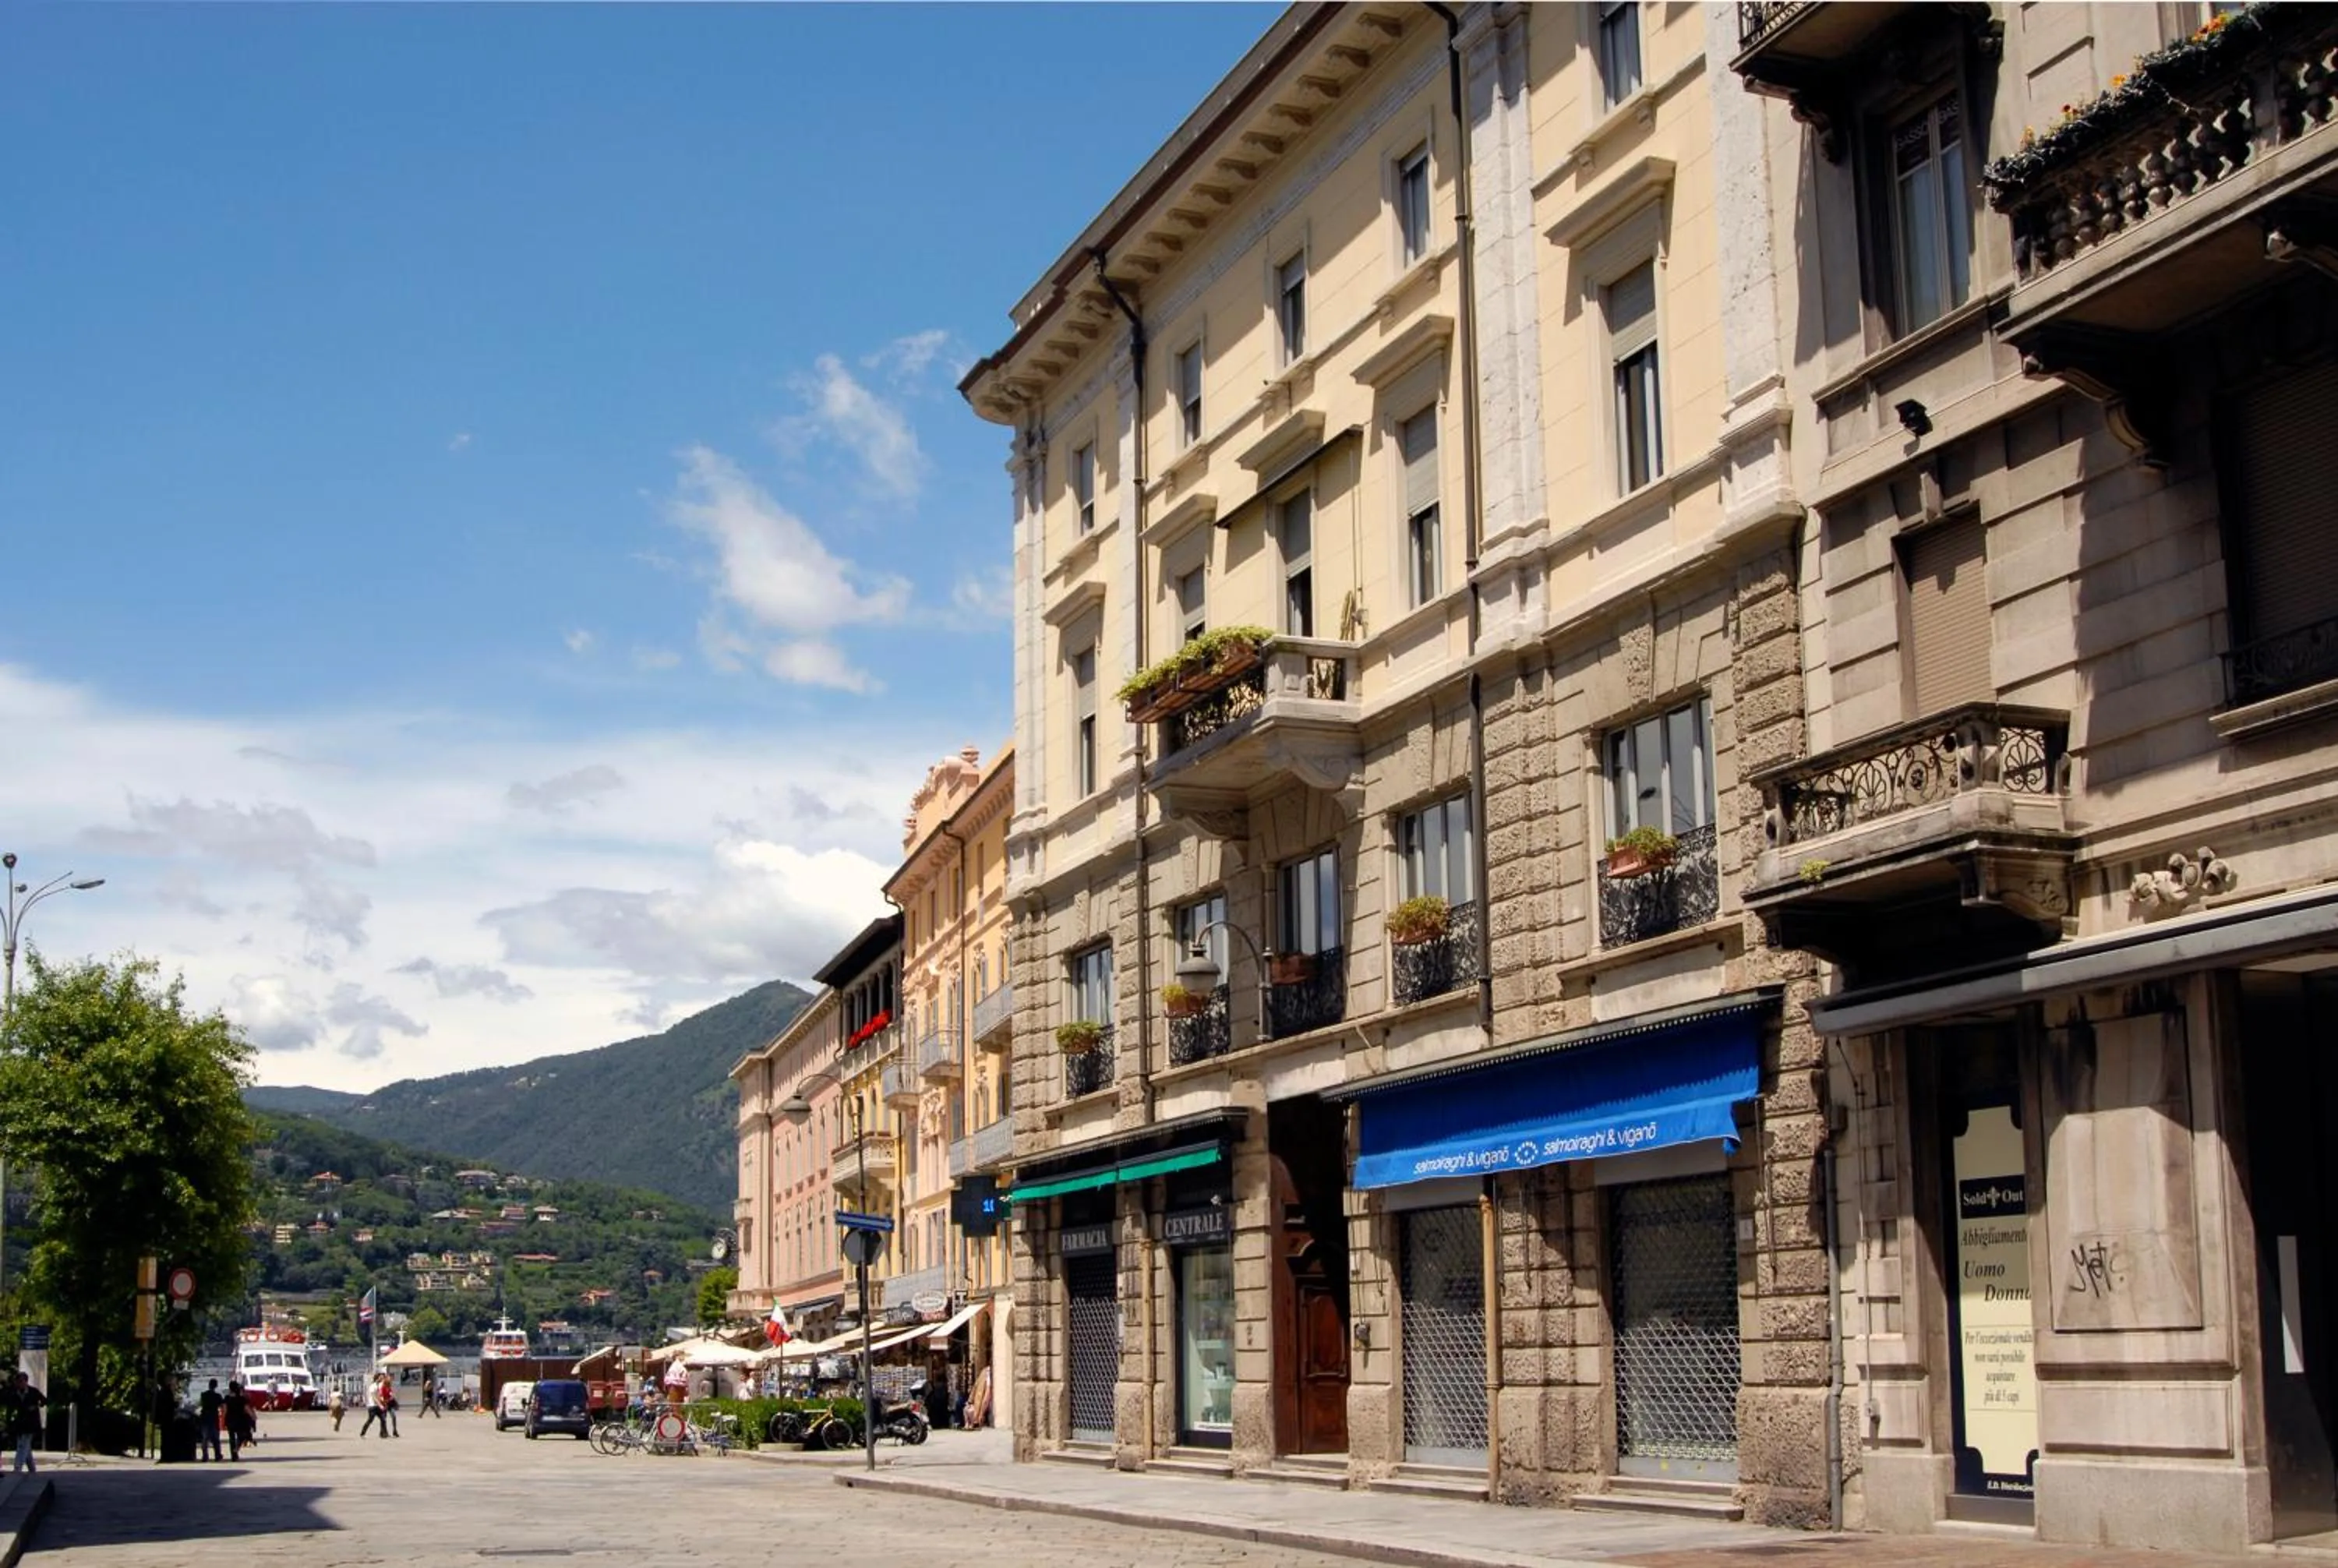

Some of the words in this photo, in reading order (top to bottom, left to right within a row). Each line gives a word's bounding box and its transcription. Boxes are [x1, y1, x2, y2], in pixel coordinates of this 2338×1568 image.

[1607, 1128, 1616, 1146] &
[1466, 1150, 1475, 1167] &
[1963, 1192, 1987, 1206] Sold
[2001, 1188, 2024, 1203] Out
[1165, 1212, 1223, 1238] CENTRALE
[1061, 1229, 1107, 1252] FARMACIA
[1964, 1260, 2005, 1279] Uomo
